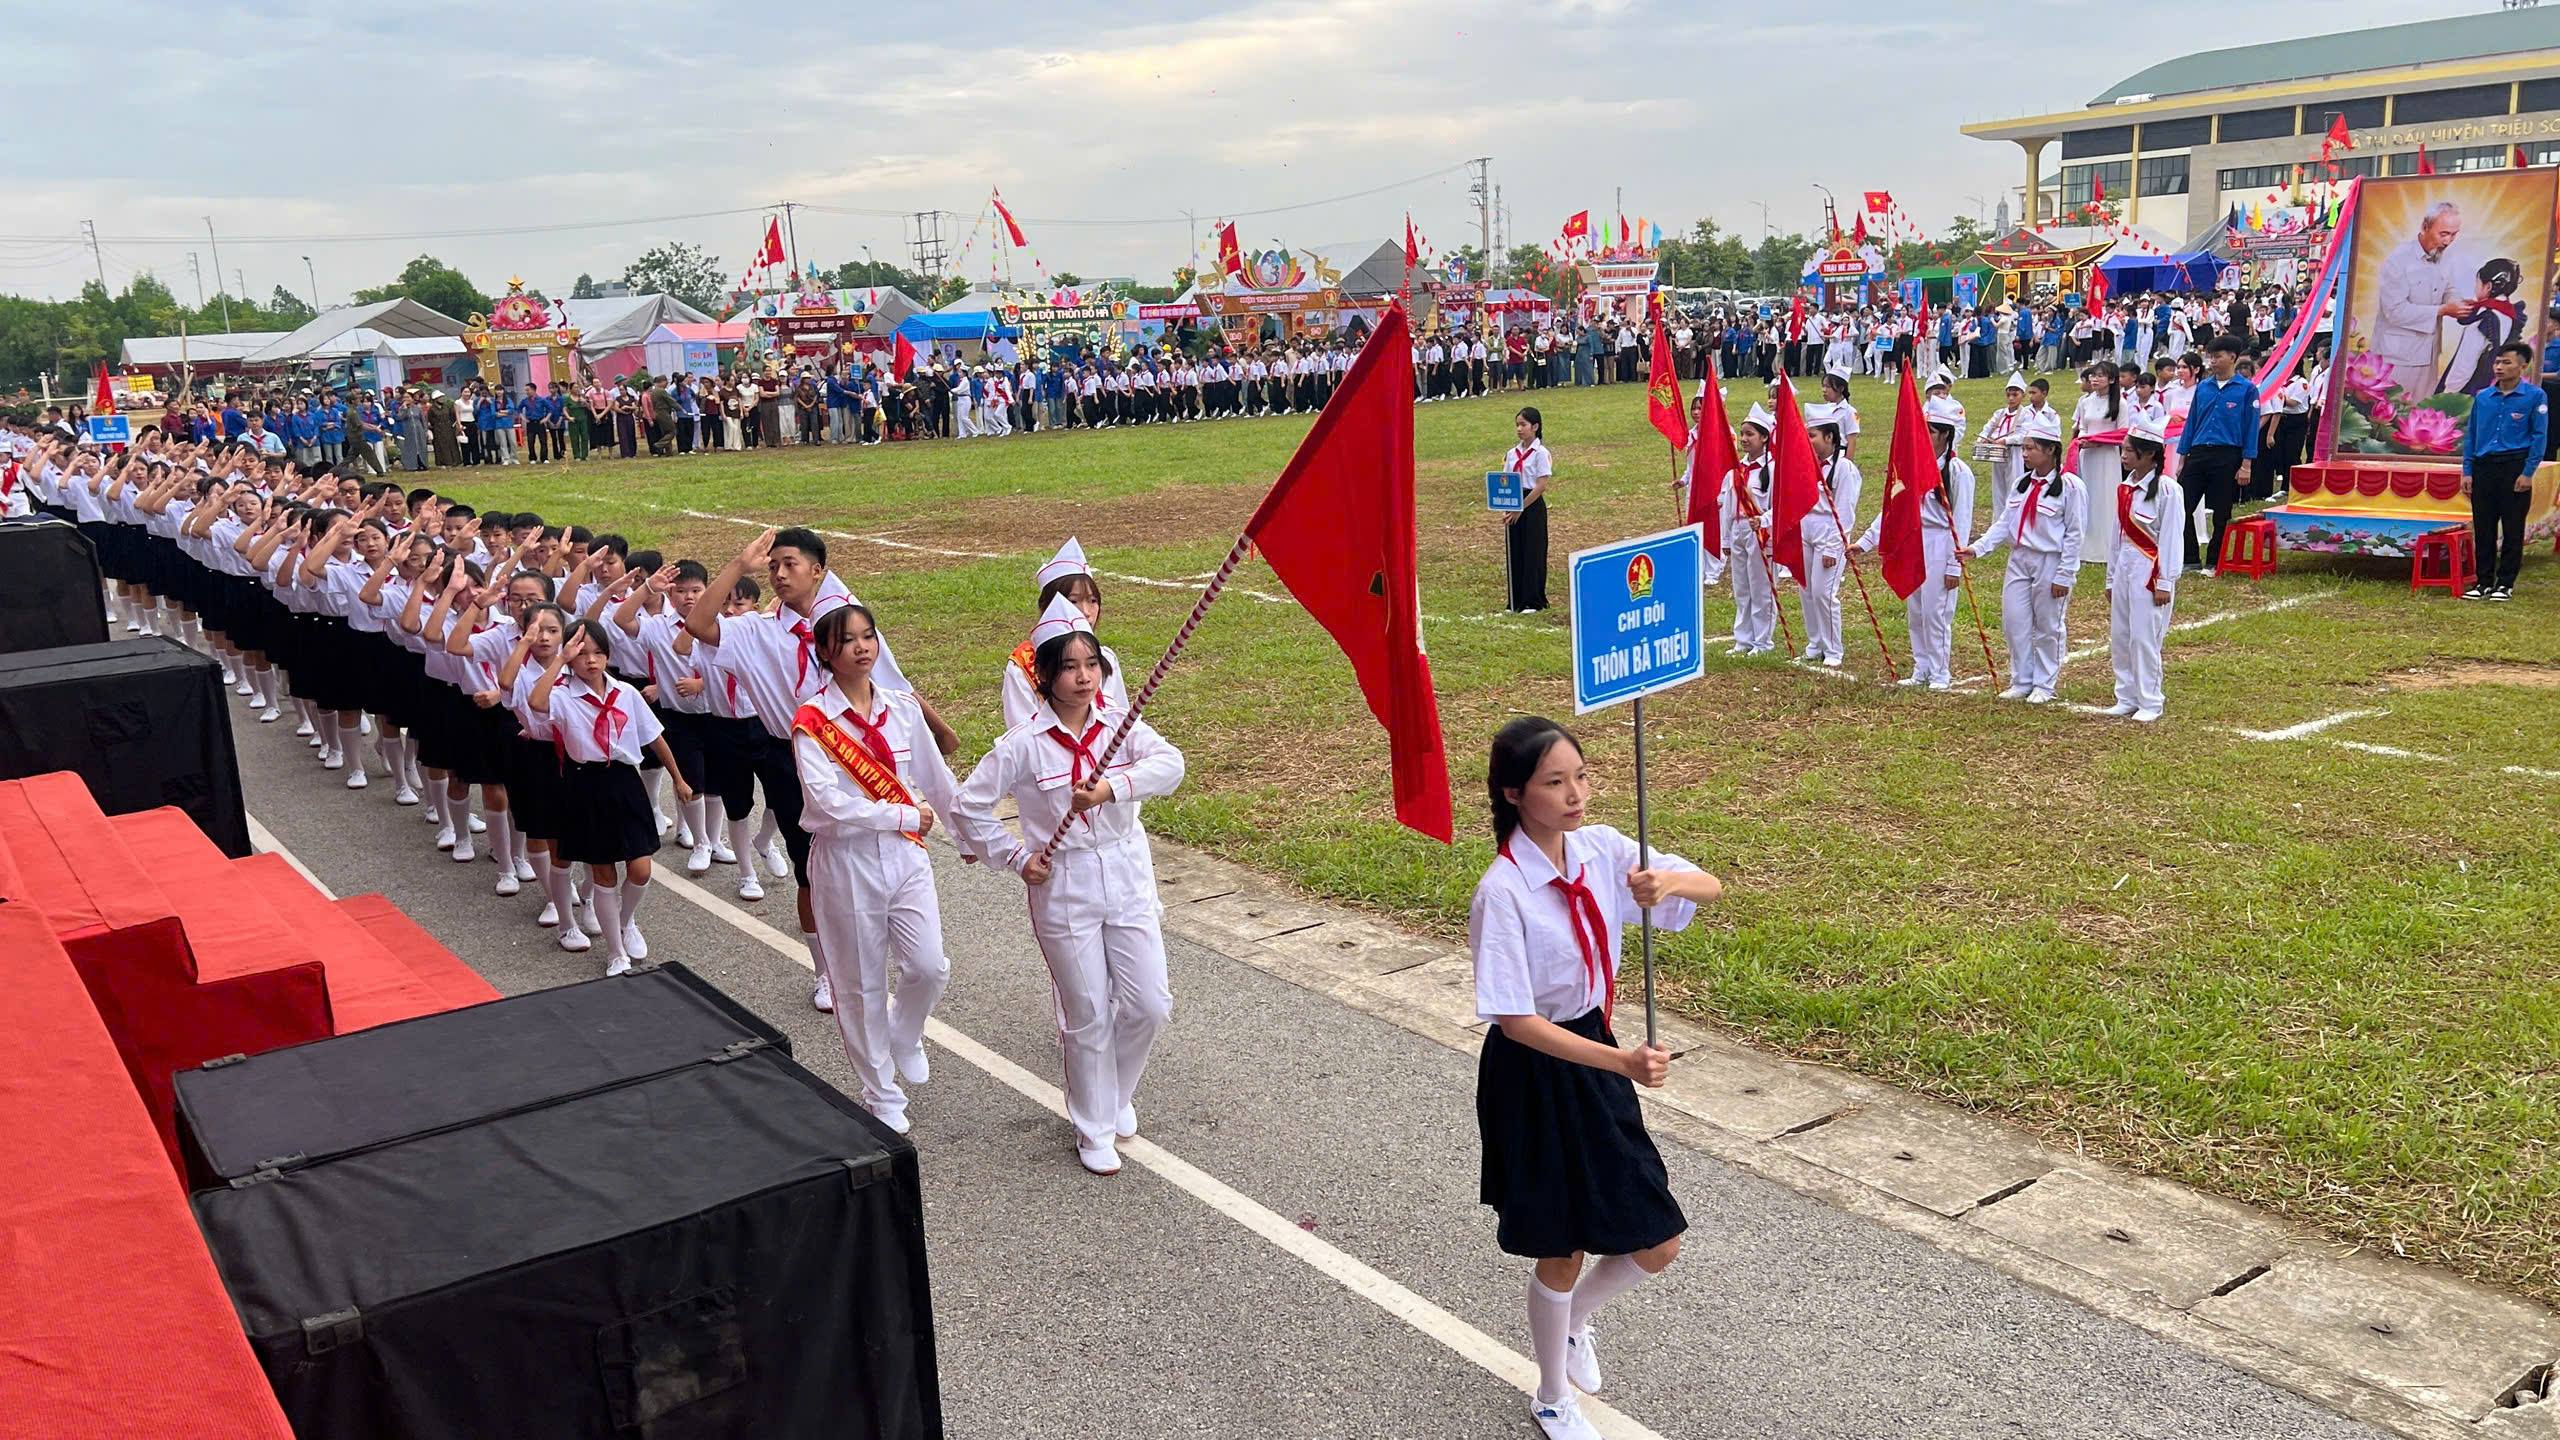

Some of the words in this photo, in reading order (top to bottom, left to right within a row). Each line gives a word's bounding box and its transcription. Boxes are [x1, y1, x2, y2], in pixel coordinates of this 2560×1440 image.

[2432, 123, 2485, 142] HUYỆN
[2490, 119, 2533, 138] TRIỆU
[1022, 311, 1038, 321] CHI
[1039, 309, 1055, 323] ĐỘI
[1056, 307, 1081, 320] THÔN
[1617, 609, 1640, 632] CHI
[1643, 600, 1665, 627] ĐỘI
[1592, 645, 1629, 686] THÔN
[1654, 627, 1689, 668] TRIỆU
[838, 740, 856, 765] ĐỘI
[855, 758, 881, 784] TNTP
[874, 777, 893, 797] HỒ
